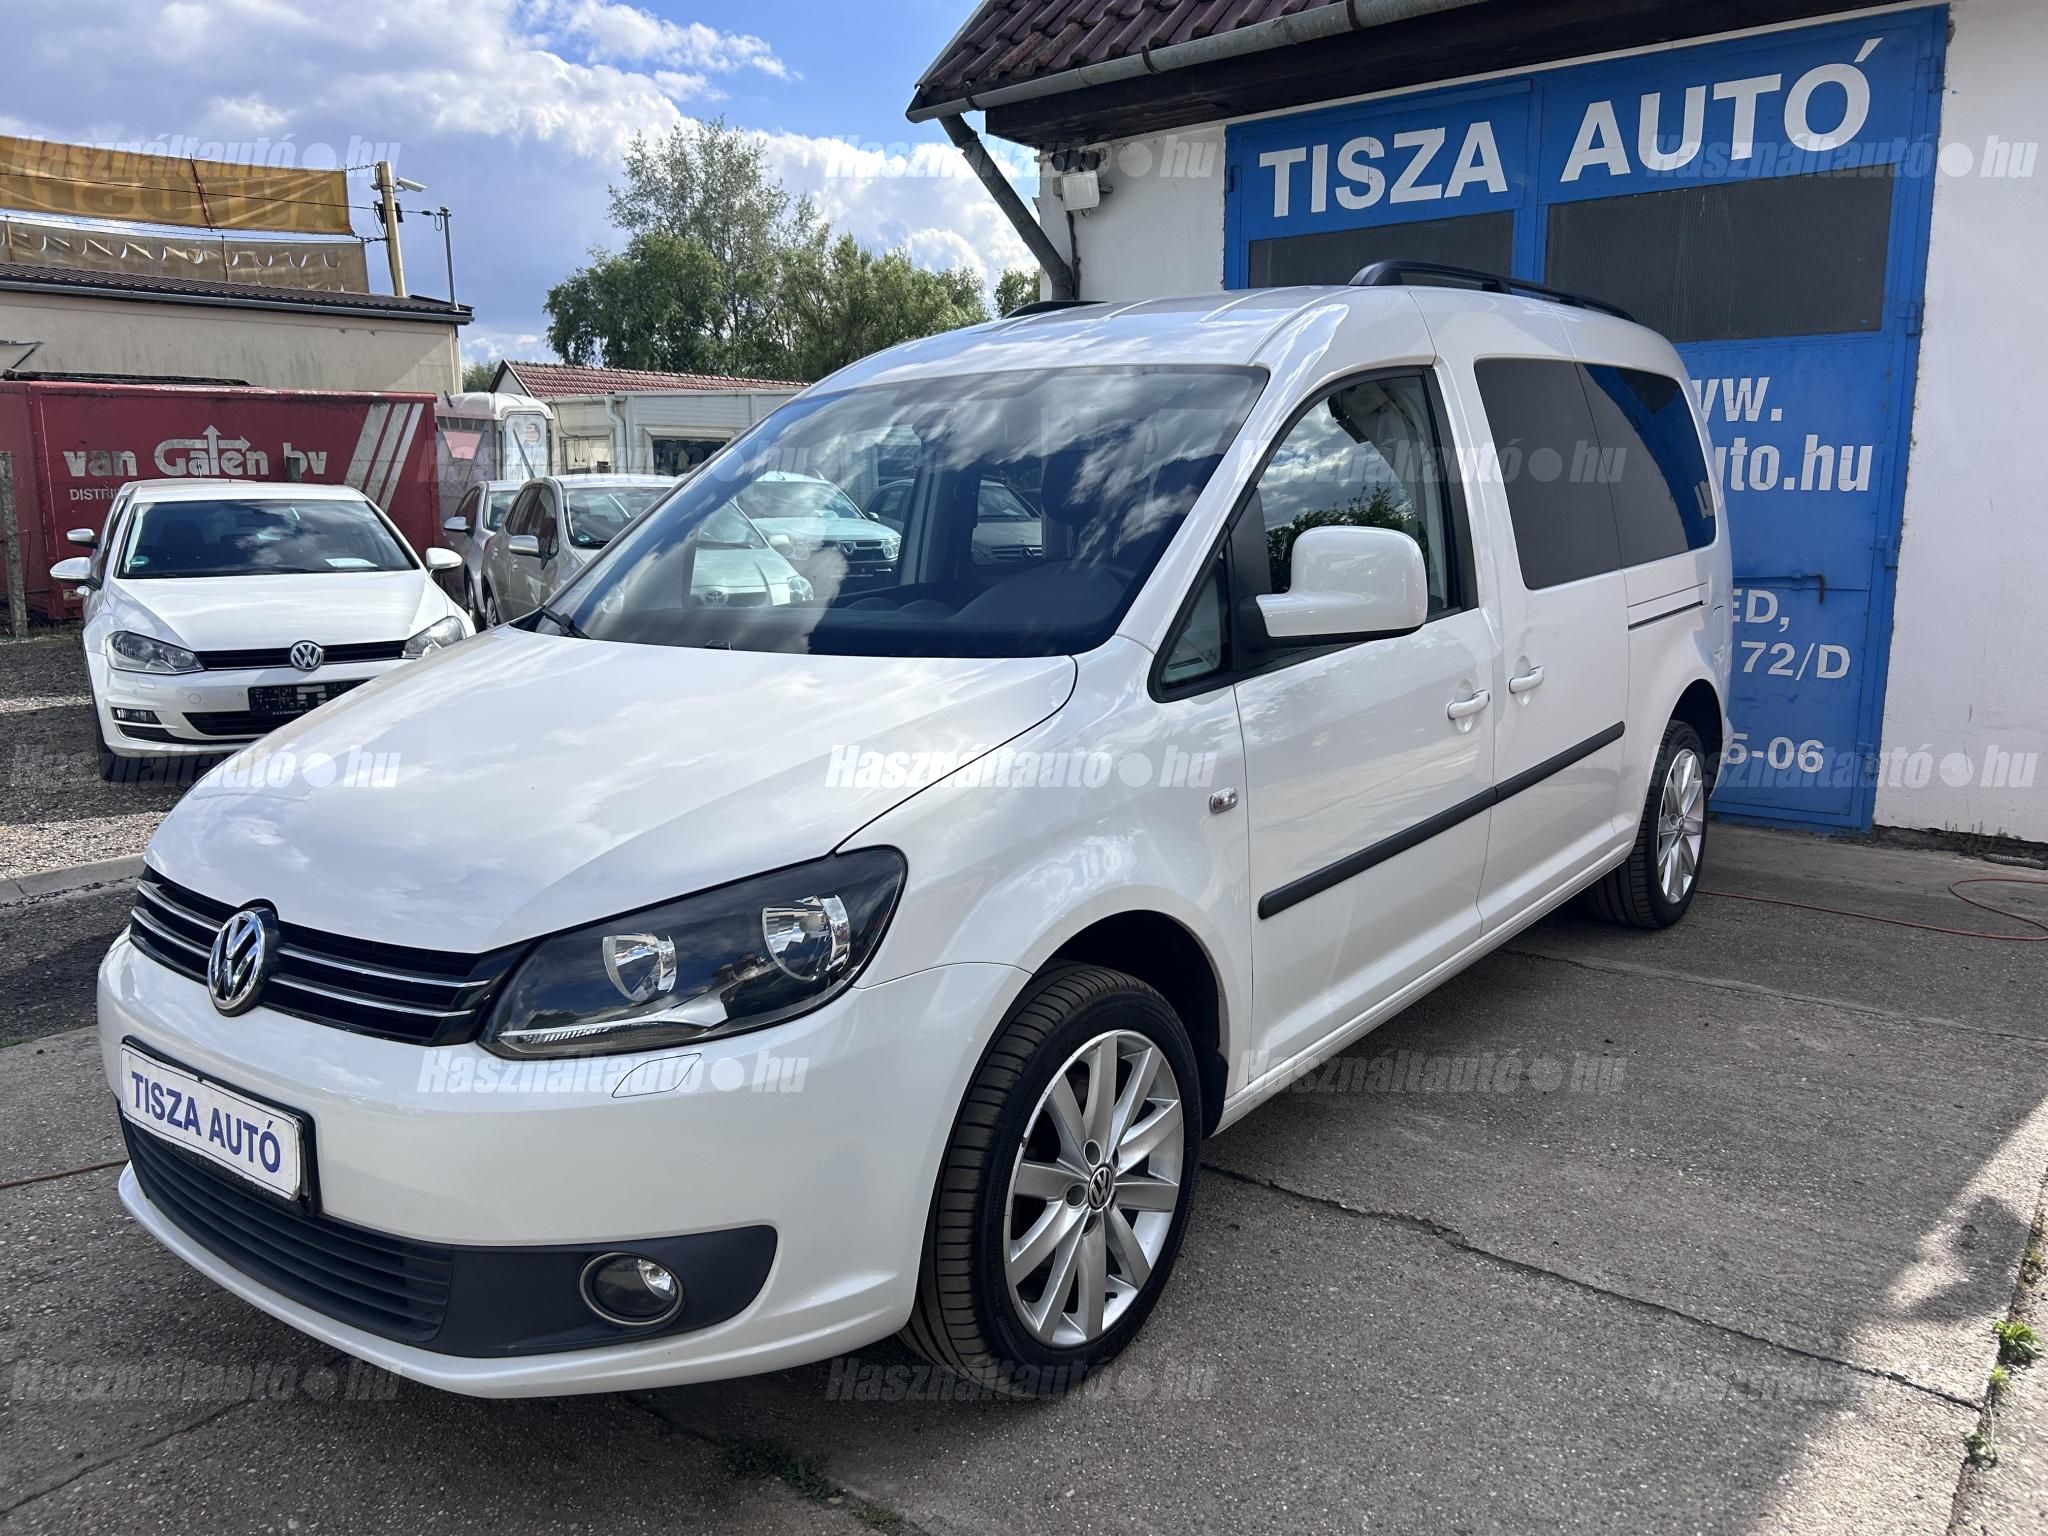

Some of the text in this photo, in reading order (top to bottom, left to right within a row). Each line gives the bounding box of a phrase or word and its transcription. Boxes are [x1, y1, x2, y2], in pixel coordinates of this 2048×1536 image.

[1259, 37, 1884, 218] TISZA AUTÓ
[63, 450, 138, 477] van
[69, 487, 121, 501] DISTRI
[1741, 641, 1851, 681] 72/D
[131, 1071, 281, 1174] TISZA AUTÓ
